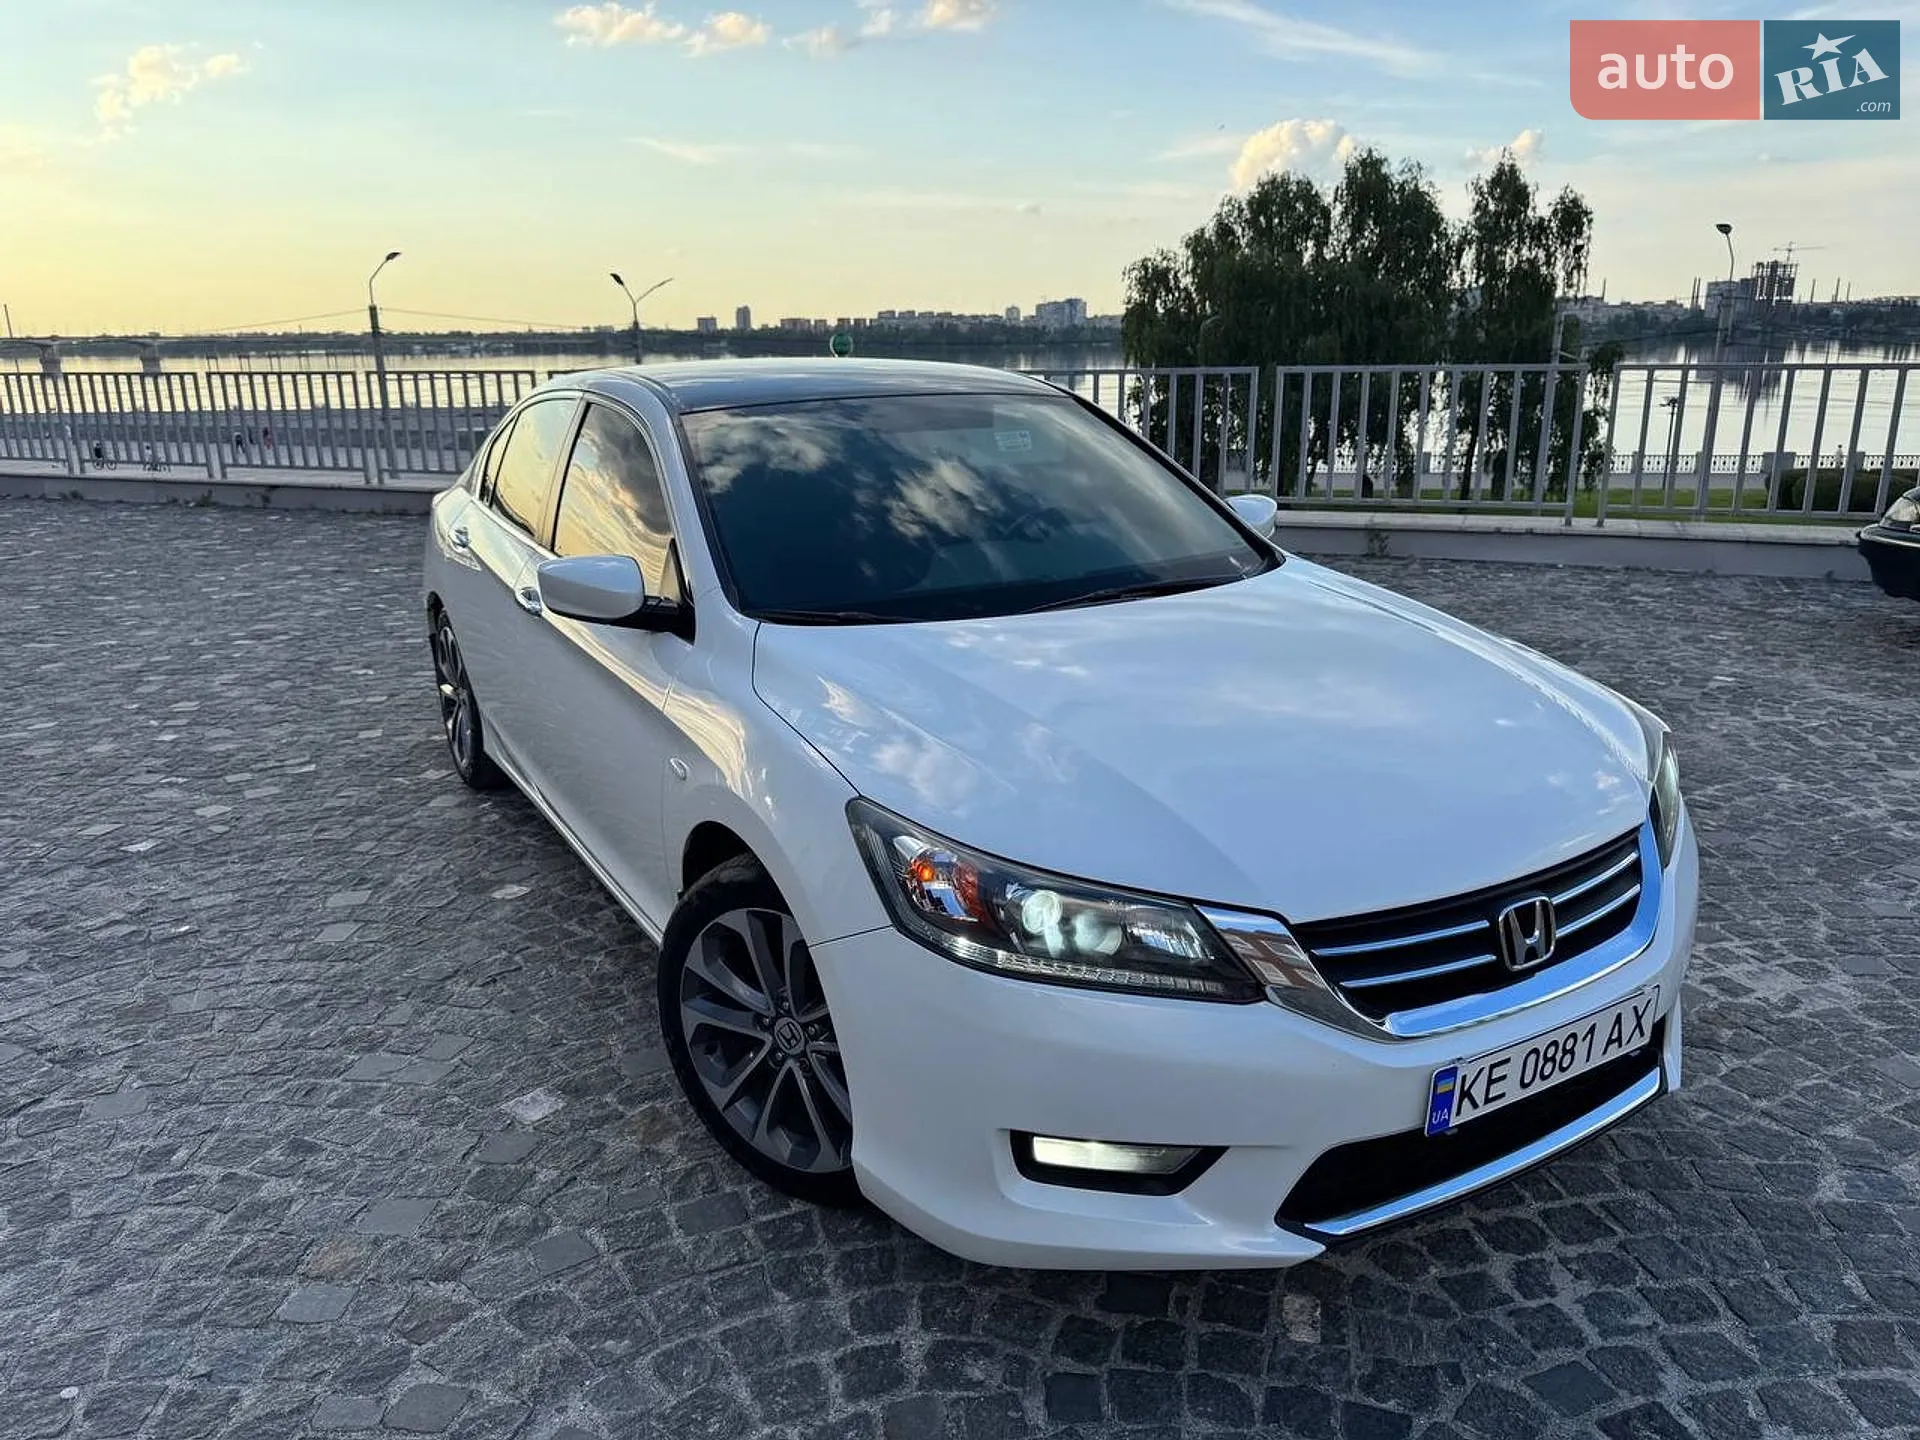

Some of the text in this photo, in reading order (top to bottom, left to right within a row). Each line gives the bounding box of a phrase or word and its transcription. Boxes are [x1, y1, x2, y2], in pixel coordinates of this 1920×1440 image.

[1455, 998, 1652, 1117] KE 0881 AX
[1432, 1109, 1449, 1124] UA
